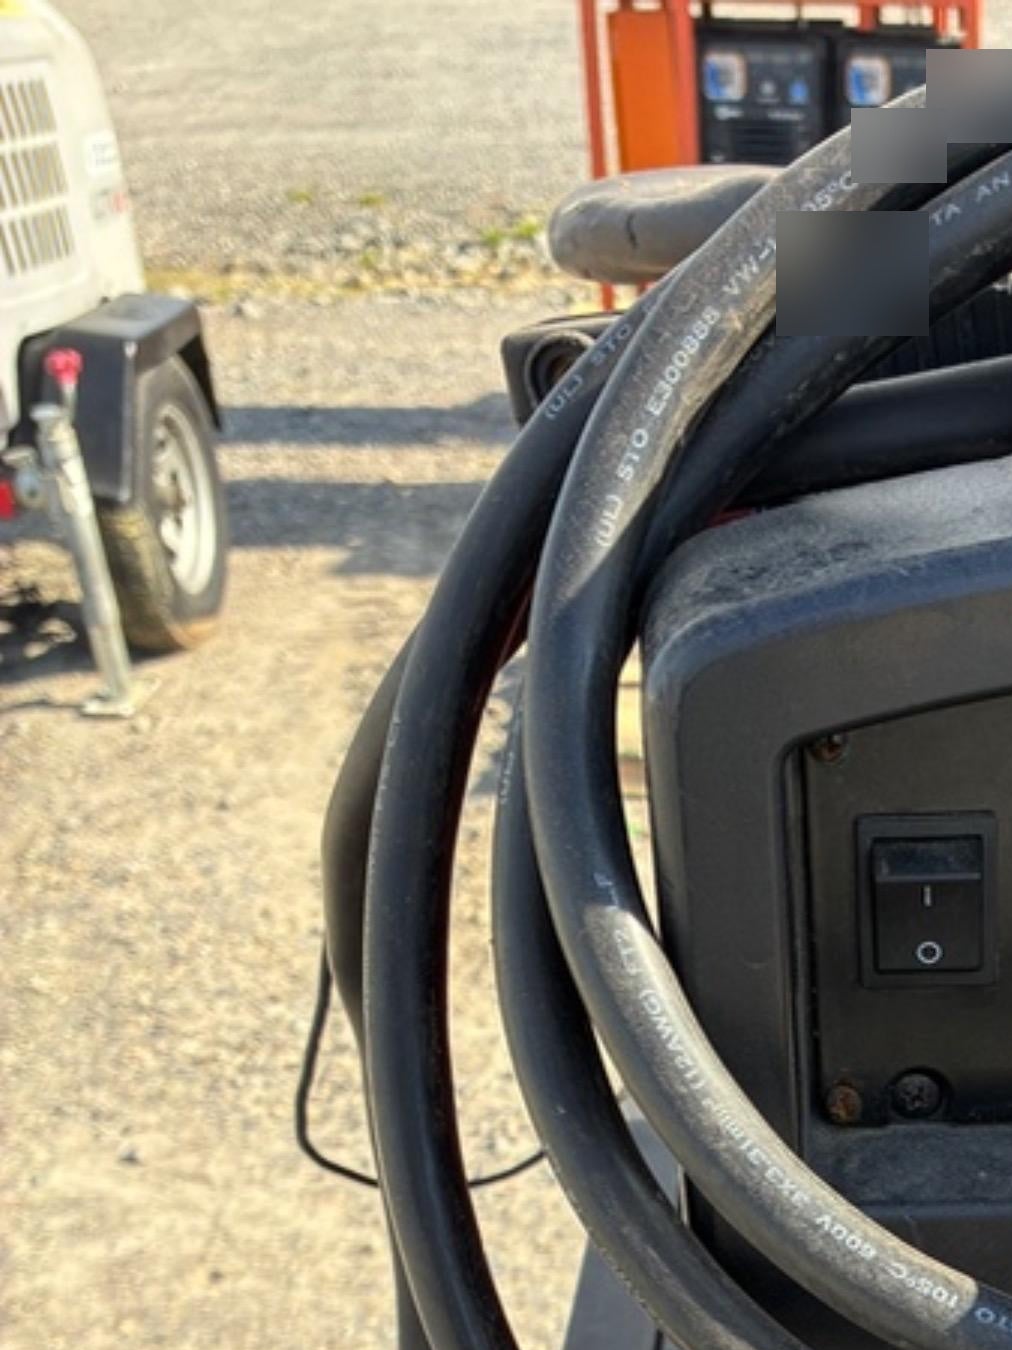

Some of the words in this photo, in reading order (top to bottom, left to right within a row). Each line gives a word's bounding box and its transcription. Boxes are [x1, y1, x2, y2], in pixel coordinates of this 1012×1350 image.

[613, 425, 650, 482] STO
[648, 308, 721, 416] E300888
[637, 991, 705, 1090] (12AWG)
[814, 1220, 877, 1260] 600V
